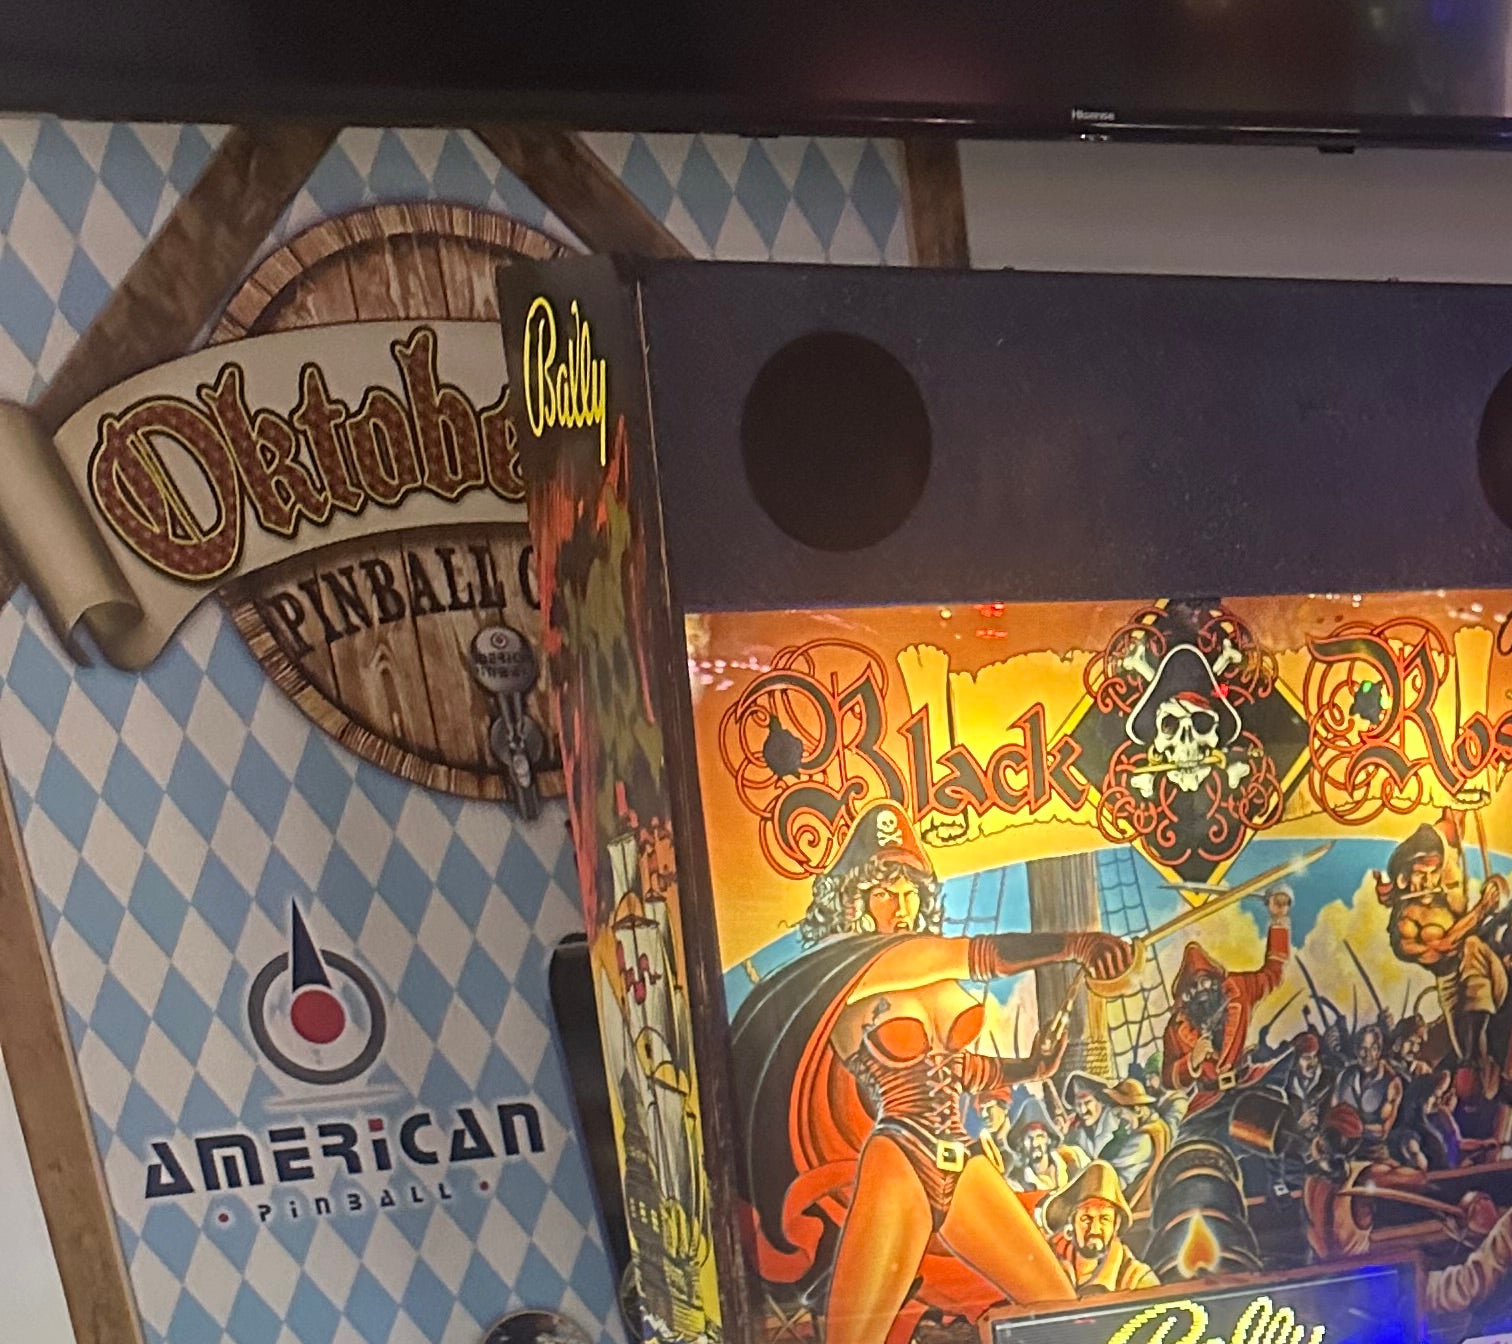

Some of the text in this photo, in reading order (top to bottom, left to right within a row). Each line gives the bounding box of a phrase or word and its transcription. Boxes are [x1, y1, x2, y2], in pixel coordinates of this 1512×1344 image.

[522, 296, 607, 467] Bally
[272, 546, 500, 657] PINBALL
[718, 637, 1093, 880] Black
[143, 1101, 547, 1200] AMERICAN
[257, 1182, 454, 1223] PINBALL
